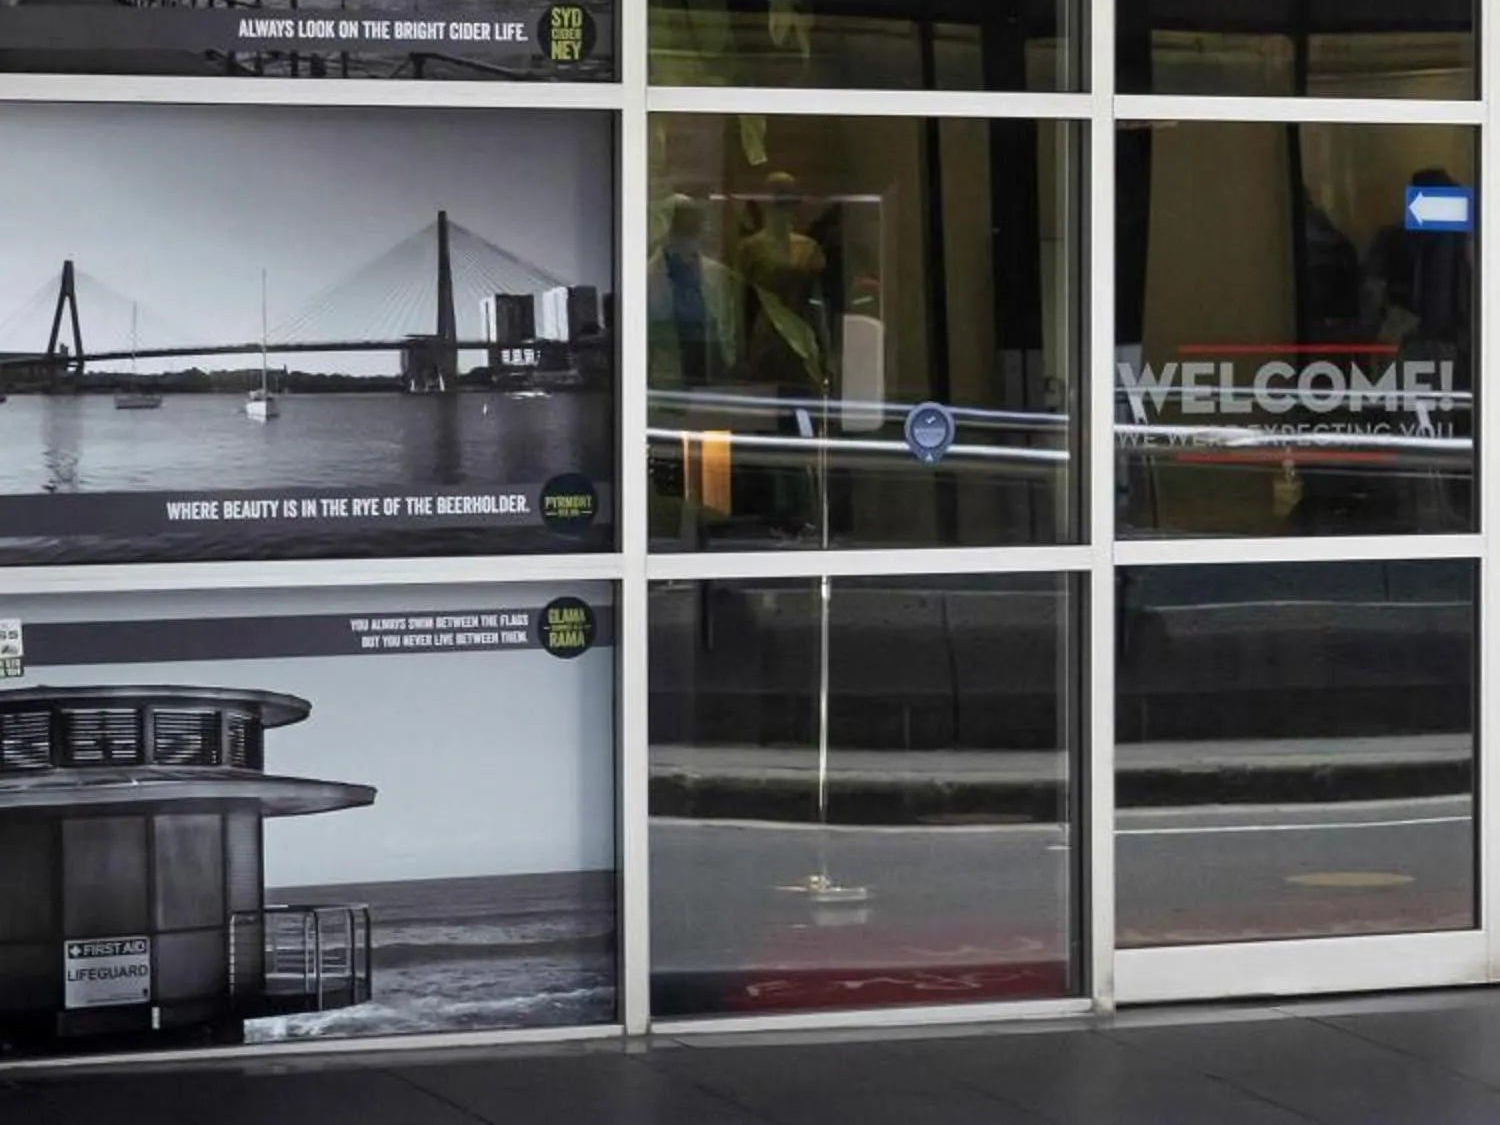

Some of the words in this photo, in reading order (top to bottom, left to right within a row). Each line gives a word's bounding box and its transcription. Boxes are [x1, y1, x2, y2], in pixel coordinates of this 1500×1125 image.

[551, 7, 583, 27] SYD
[238, 19, 295, 38] ALWAYS
[298, 19, 336, 38] LOOK
[339, 20, 359, 38] ON
[362, 20, 391, 39] THE
[394, 21, 446, 40] BRIGHT
[449, 22, 491, 41] CIDER
[494, 23, 529, 42] LIFE.
[551, 41, 583, 60] NEY
[1117, 361, 1454, 414] WELCOME!
[166, 502, 219, 520] WHERE
[223, 500, 279, 519] BEAUTY
[283, 499, 297, 517] IS
[301, 499, 317, 517] IN
[320, 499, 349, 517] THE
[352, 498, 380, 516] RYE
[383, 497, 401, 516] OF
[405, 497, 433, 515] THE
[436, 495, 531, 514] BEERHOLDER.
[549, 632, 585, 648] RAMA
[83, 942, 122, 956] FIRST
[122, 939, 146, 954] AID
[67, 964, 149, 982] LIFEGUARD
